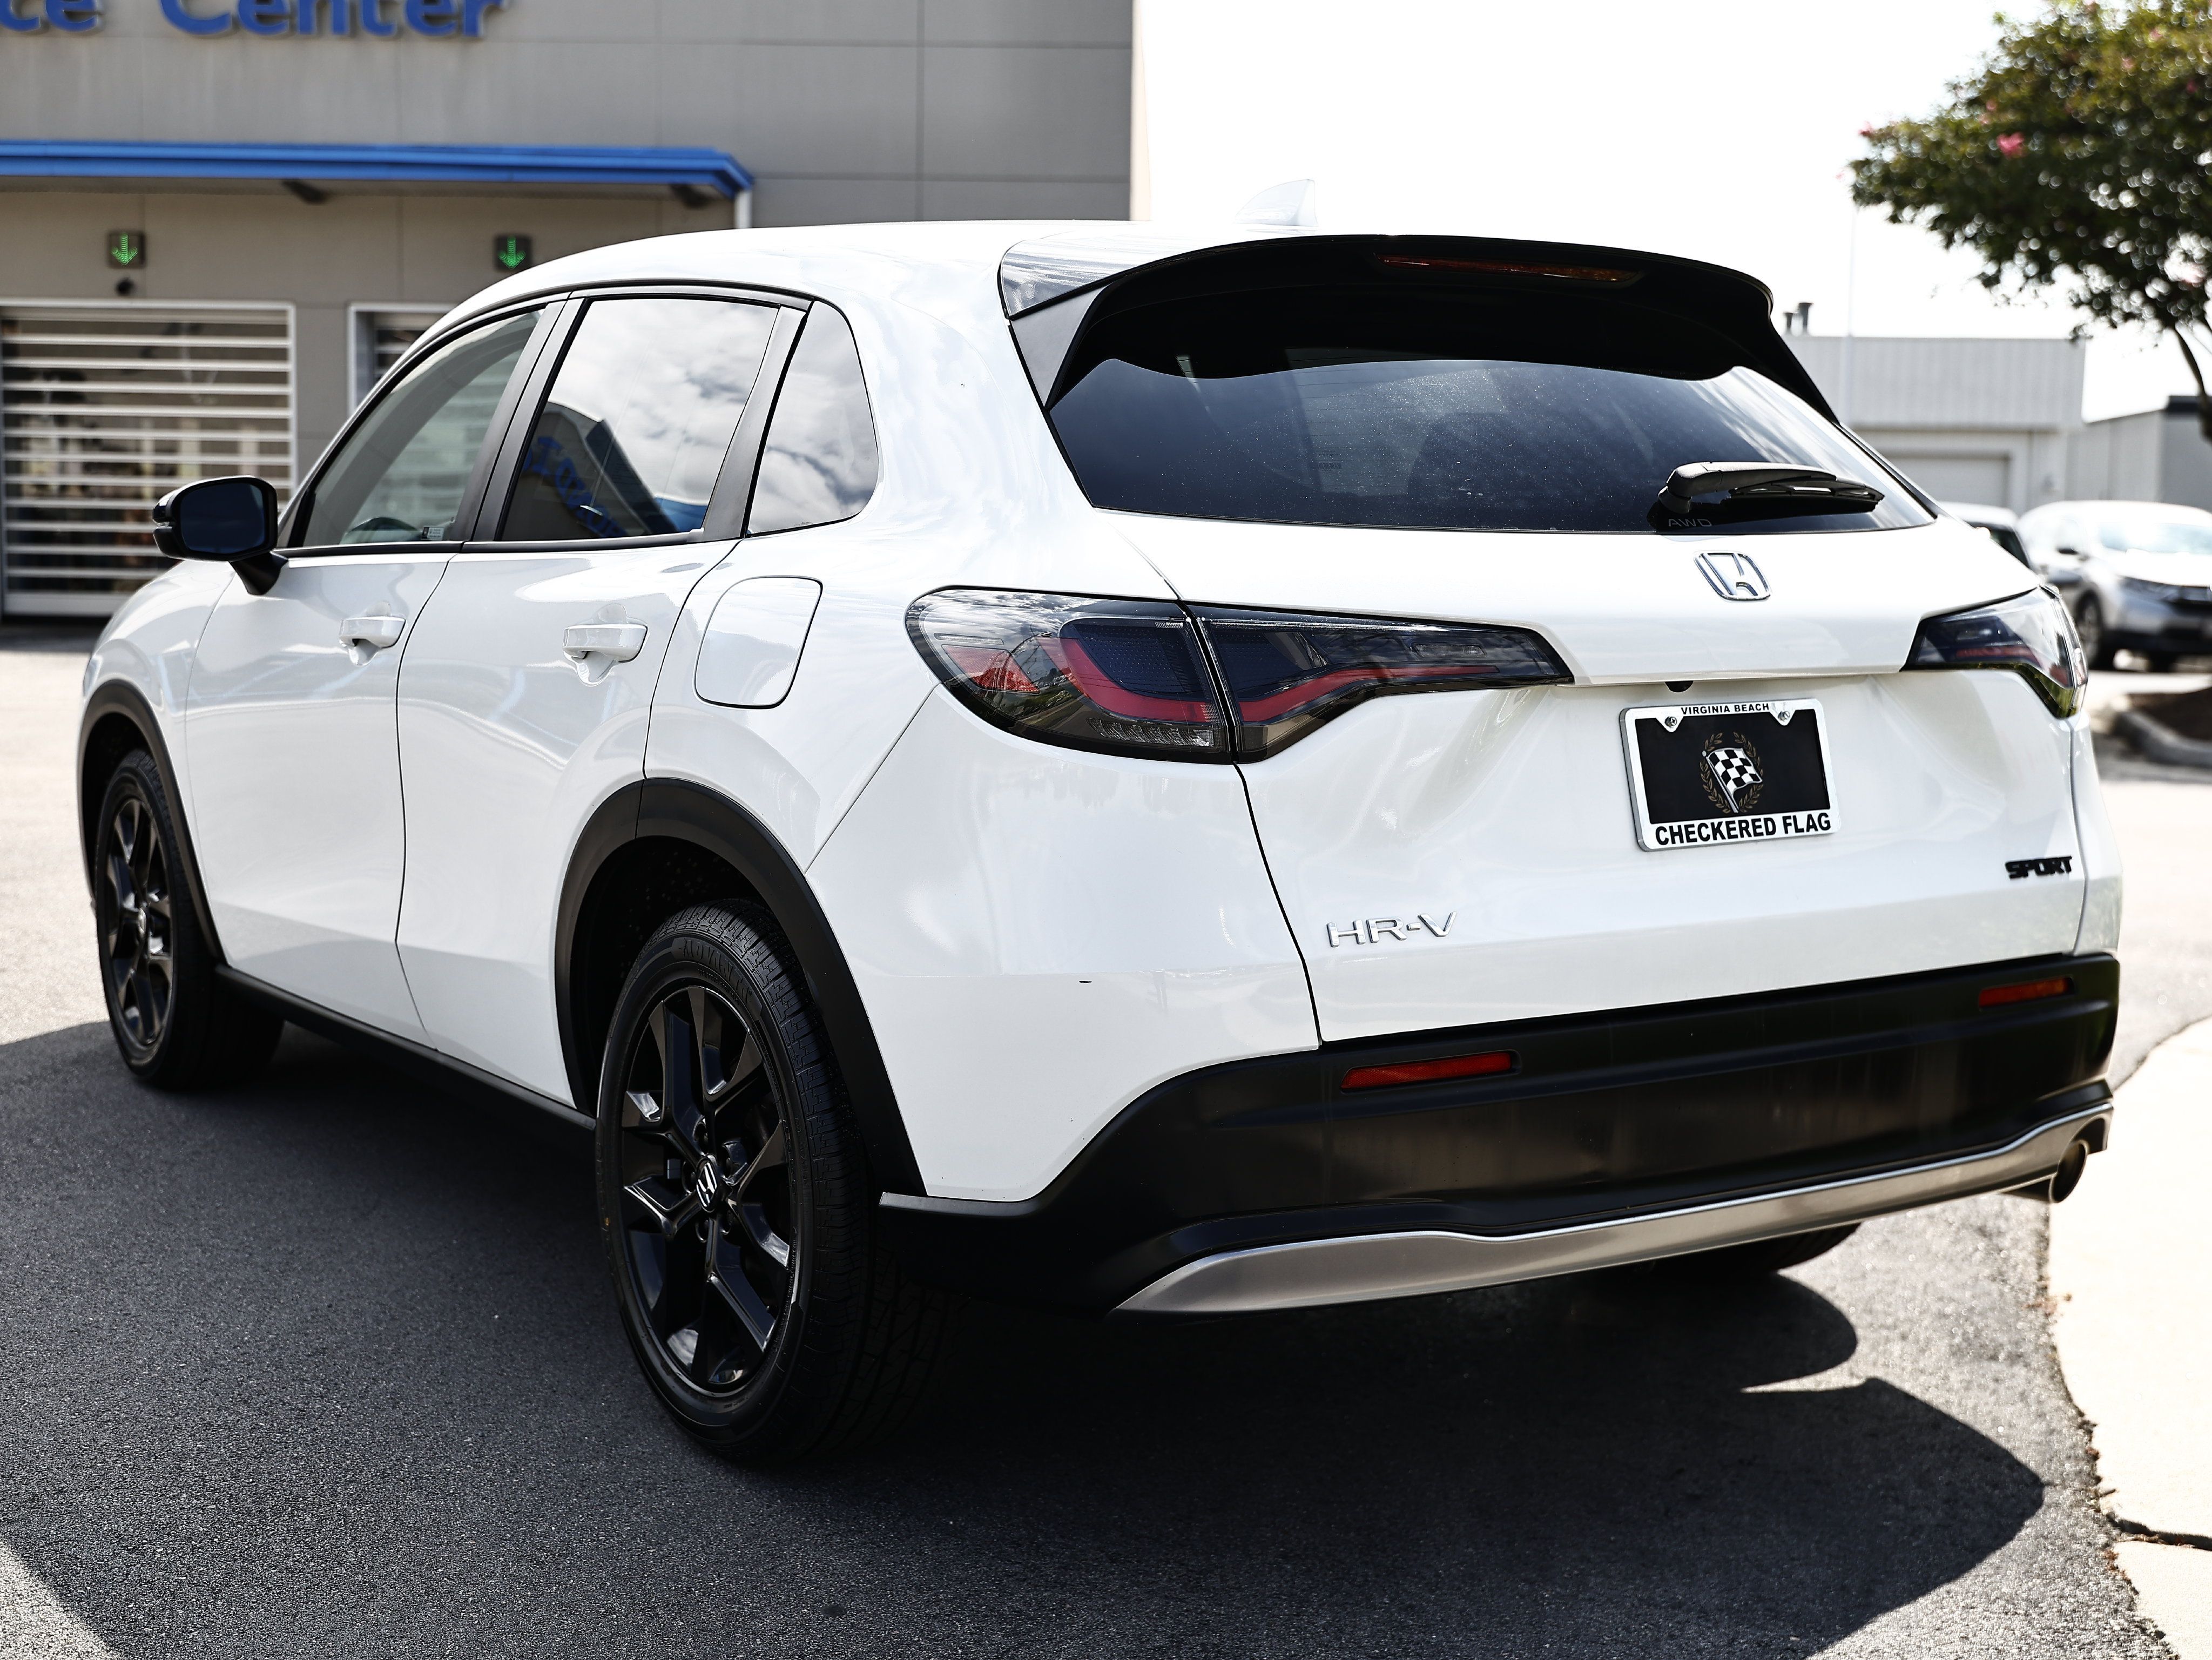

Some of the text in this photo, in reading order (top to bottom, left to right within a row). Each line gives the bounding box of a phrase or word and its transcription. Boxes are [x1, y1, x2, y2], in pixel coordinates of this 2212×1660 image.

[161, 0, 503, 37] Center
[1668, 518, 1712, 527] AWD
[1681, 703, 1769, 715] VIRGINIA BEACH
[1655, 812, 1831, 846] CHECKERED FLAG
[2005, 856, 2072, 879] SPORT
[1326, 911, 1457, 948] HR-V
